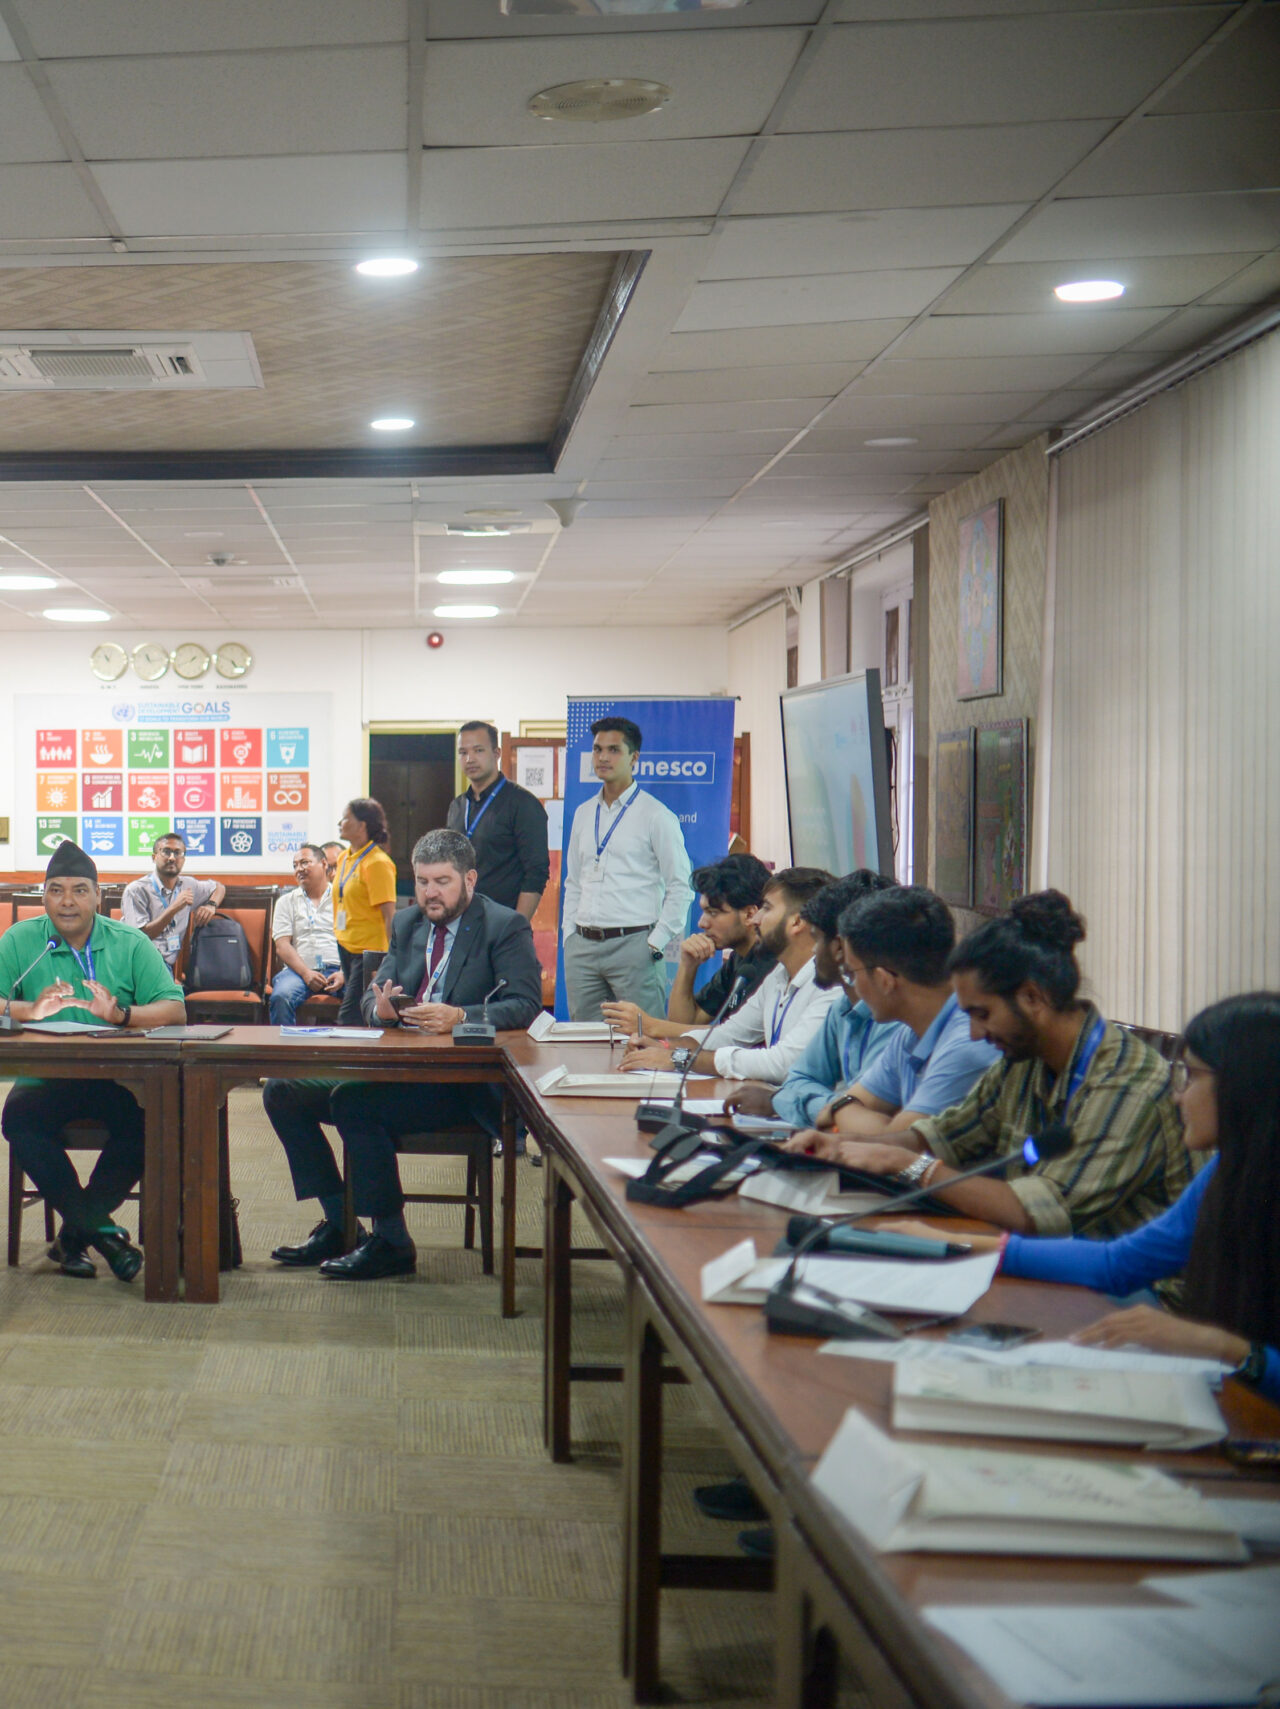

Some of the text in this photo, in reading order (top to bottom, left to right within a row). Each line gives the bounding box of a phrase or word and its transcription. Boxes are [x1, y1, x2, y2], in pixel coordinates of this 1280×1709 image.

[182, 701, 231, 713] GOALS
[679, 811, 697, 824] and
[268, 843, 299, 853] GOAL
